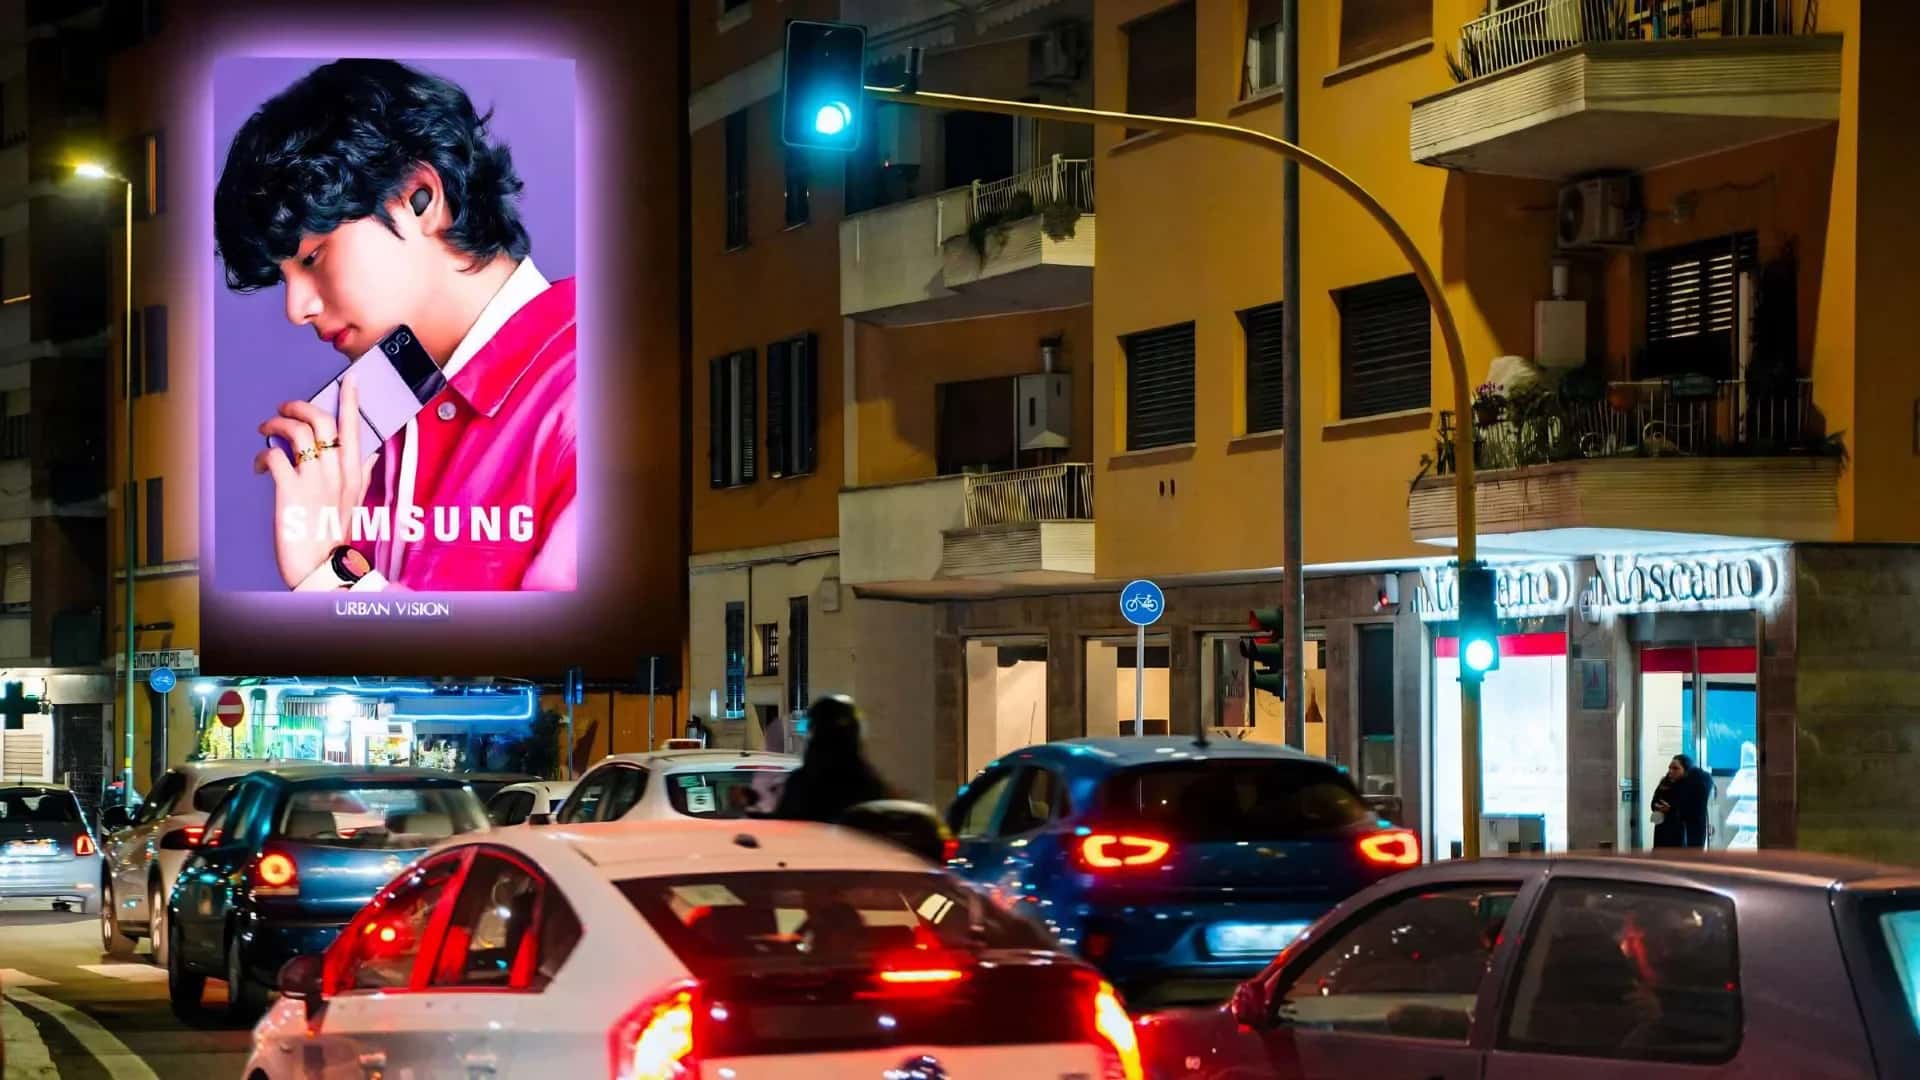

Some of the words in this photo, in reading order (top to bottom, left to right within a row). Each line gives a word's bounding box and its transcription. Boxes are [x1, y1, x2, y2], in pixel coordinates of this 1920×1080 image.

[281, 504, 536, 543] SAMSUNG
[335, 600, 391, 617] URBAN
[395, 600, 450, 617] VISION
